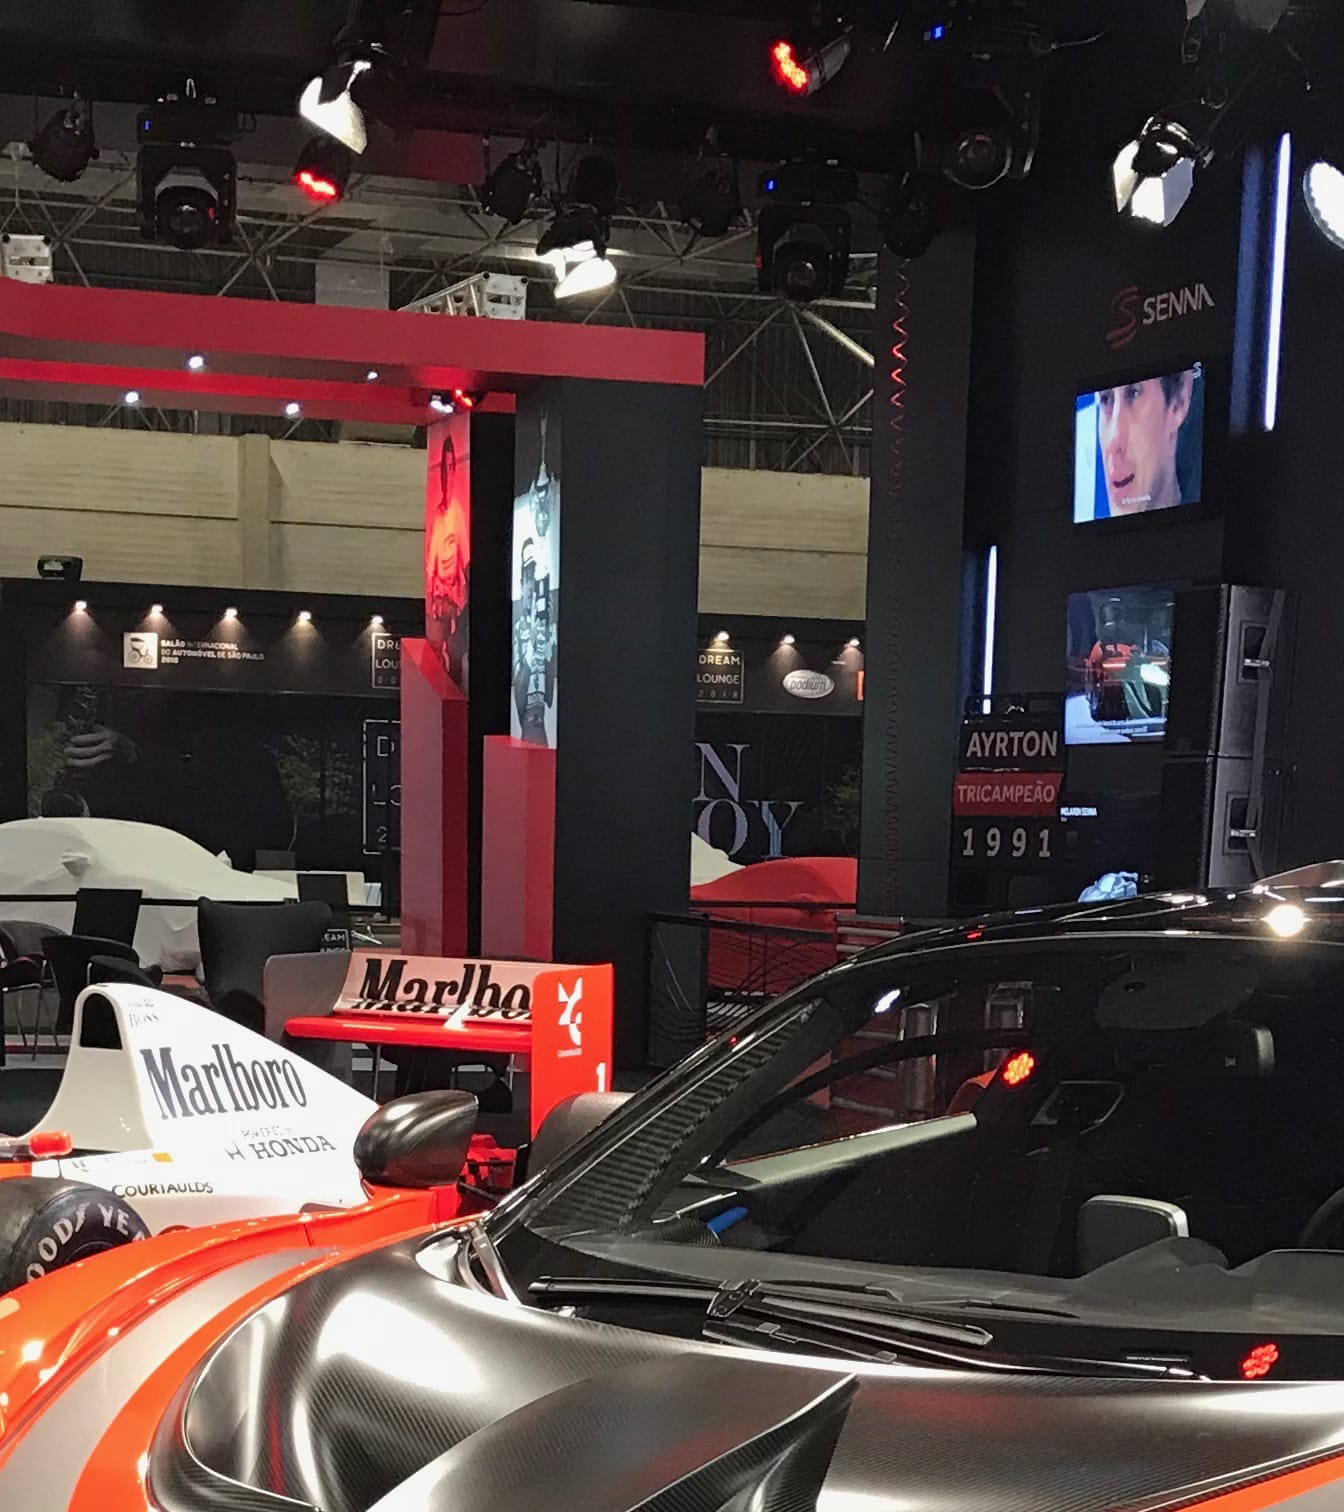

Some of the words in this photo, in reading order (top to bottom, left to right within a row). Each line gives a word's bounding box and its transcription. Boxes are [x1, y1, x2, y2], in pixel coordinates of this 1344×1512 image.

[1142, 283, 1215, 325] SENNA
[698, 654, 741, 666] DREAM
[696, 673, 740, 685] LOUNGE
[788, 675, 828, 692] podium
[966, 730, 1058, 757] AYRTON
[958, 780, 1055, 803] TRICAMPEÃO
[353, 958, 532, 1016] Marlbo
[140, 1043, 307, 1120] Marlboro
[248, 1135, 336, 1160] HONDA
